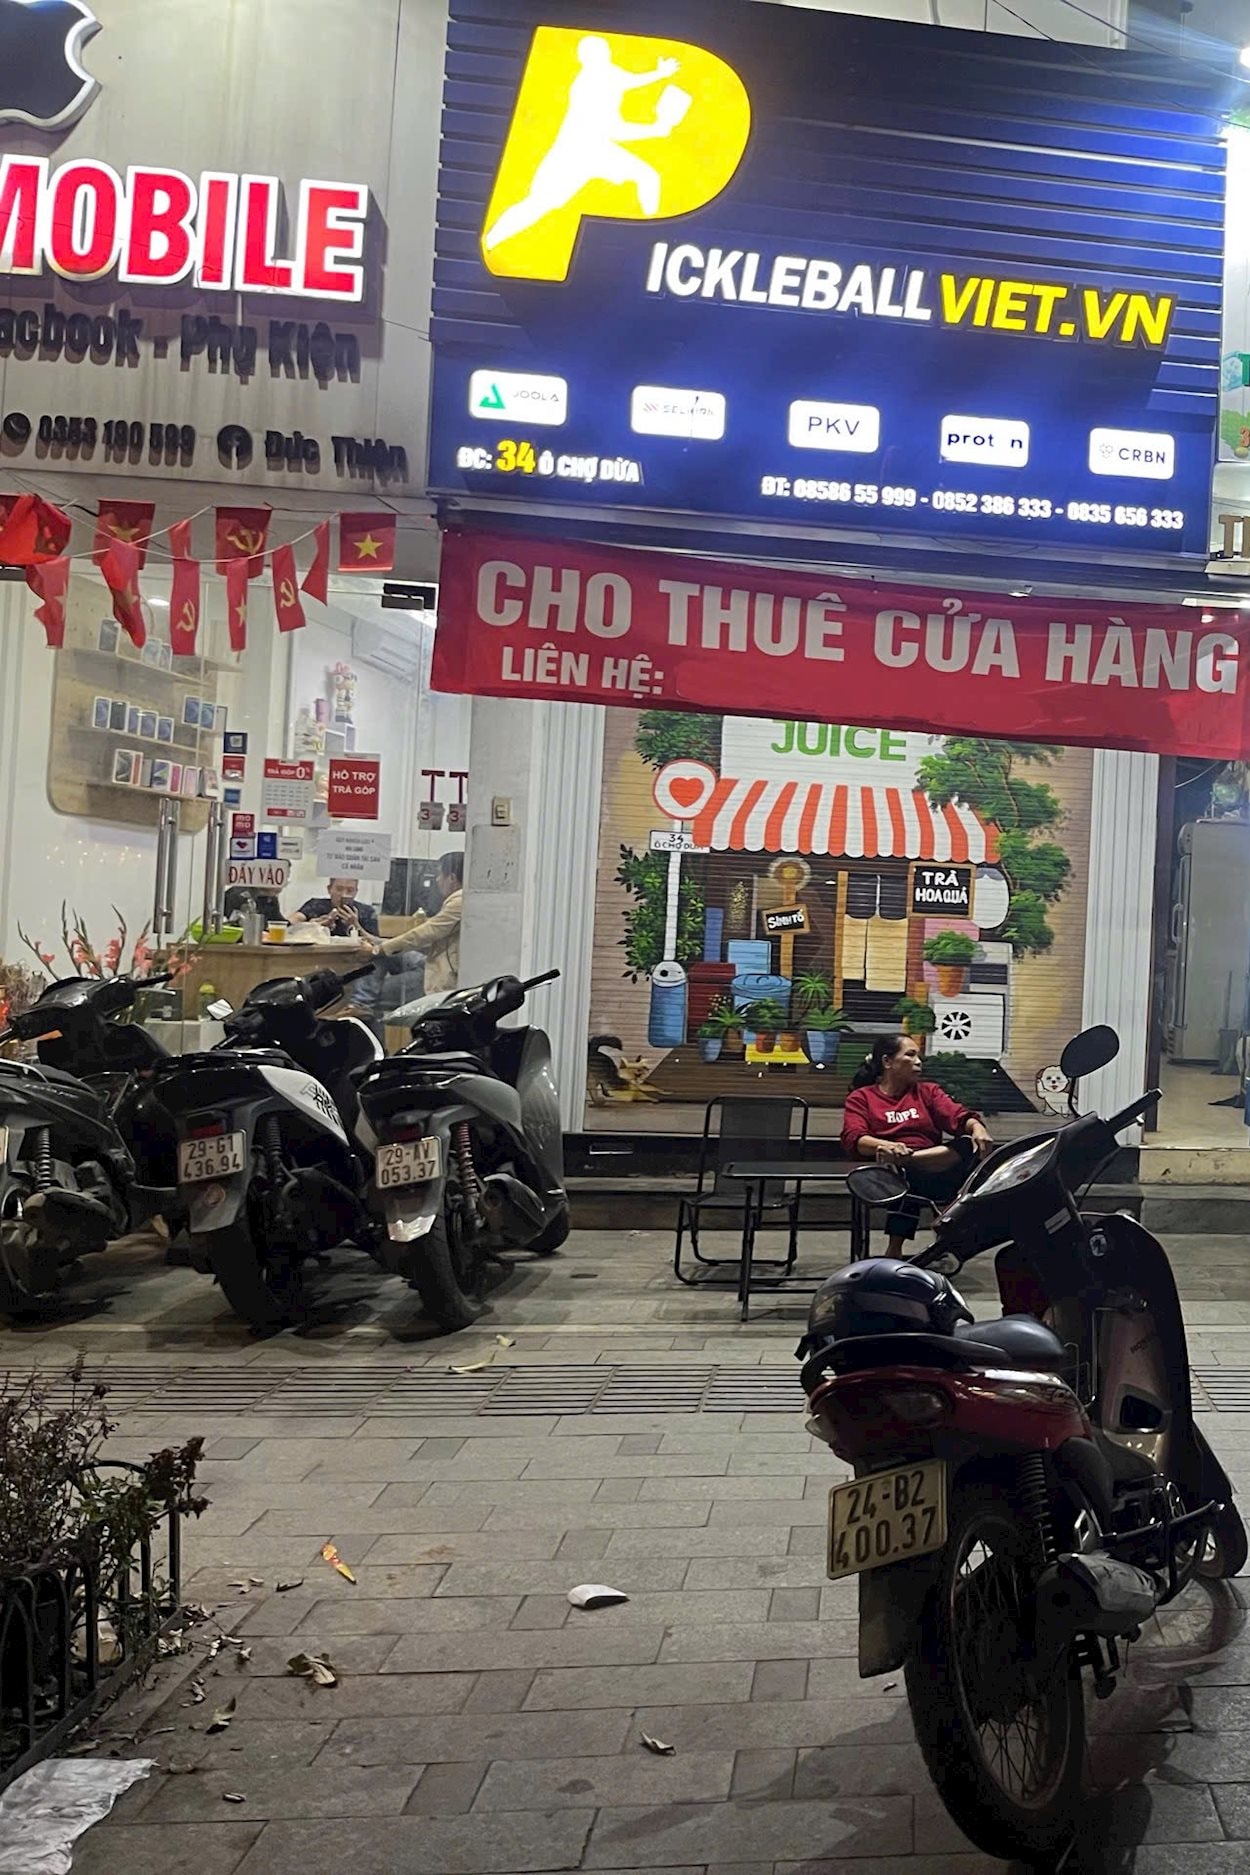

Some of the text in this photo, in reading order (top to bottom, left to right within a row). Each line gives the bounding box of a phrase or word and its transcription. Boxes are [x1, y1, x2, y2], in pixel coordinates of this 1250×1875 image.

[808, 416, 860, 437] PKV
[457, 446, 493, 470] ĐC:
[496, 439, 536, 473] 34
[557, 455, 599, 483] CHỢ
[1118, 447, 1167, 465] CRBN
[854, 483, 878, 504] 55
[881, 486, 916, 507] 999
[932, 490, 978, 513] 0852
[1017, 497, 1052, 518] 333
[1067, 502, 1112, 524] 0835
[1150, 508, 1184, 530] 333
[476, 560, 1240, 694] CHO THUÊ CỬA HÀNG
[501, 642, 665, 699] LIÊN HỆ:
[770, 718, 907, 761] JUICE
[669, 833, 684, 843] 34
[885, 1108, 919, 1123] HOPE
[187, 1134, 235, 1160] 29-G1
[386, 1141, 430, 1166] 29-AV
[184, 1153, 241, 1180] 436.94
[381, 1160, 436, 1185] 053.37
[846, 1470, 925, 1525] 24-B2
[835, 1505, 938, 1569] 400.37
